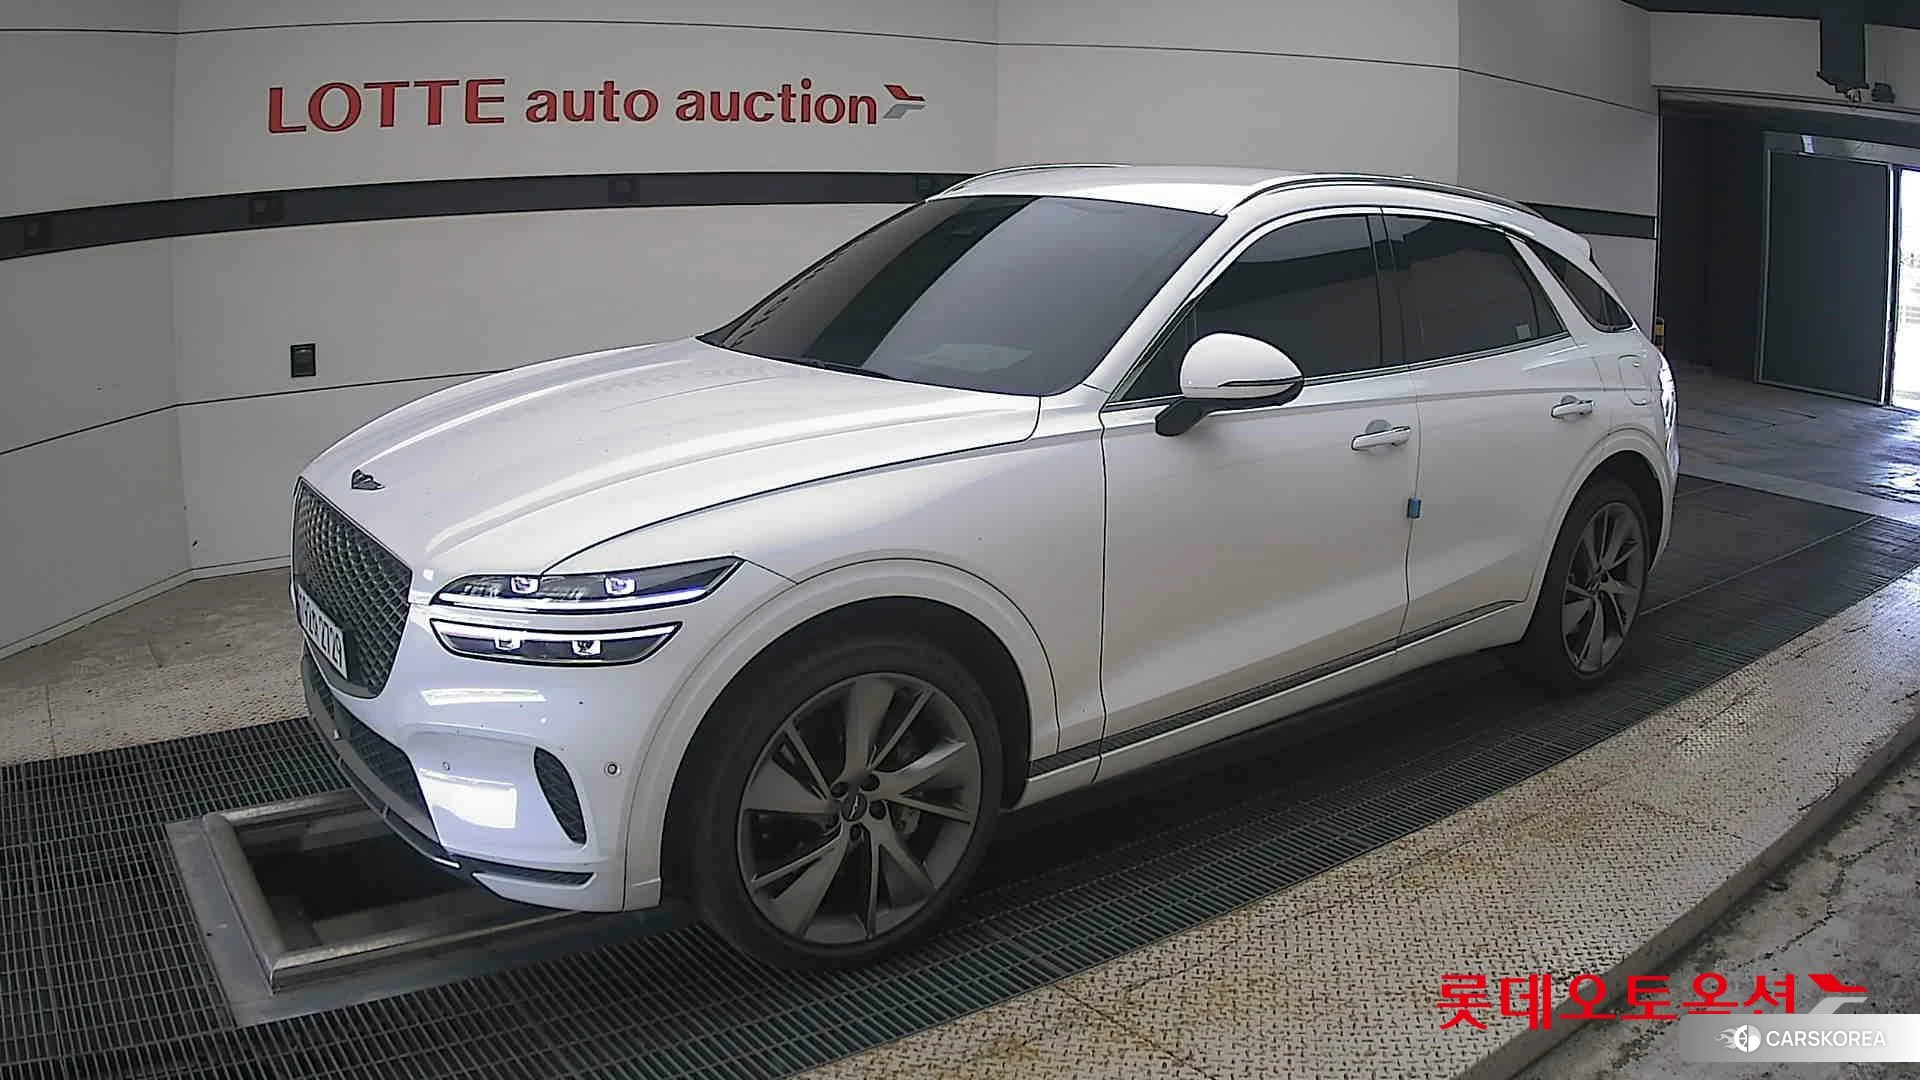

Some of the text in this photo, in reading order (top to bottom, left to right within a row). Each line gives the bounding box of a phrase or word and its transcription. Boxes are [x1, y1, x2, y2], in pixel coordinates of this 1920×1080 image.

[268, 77, 878, 134] LOTTE auto auction
